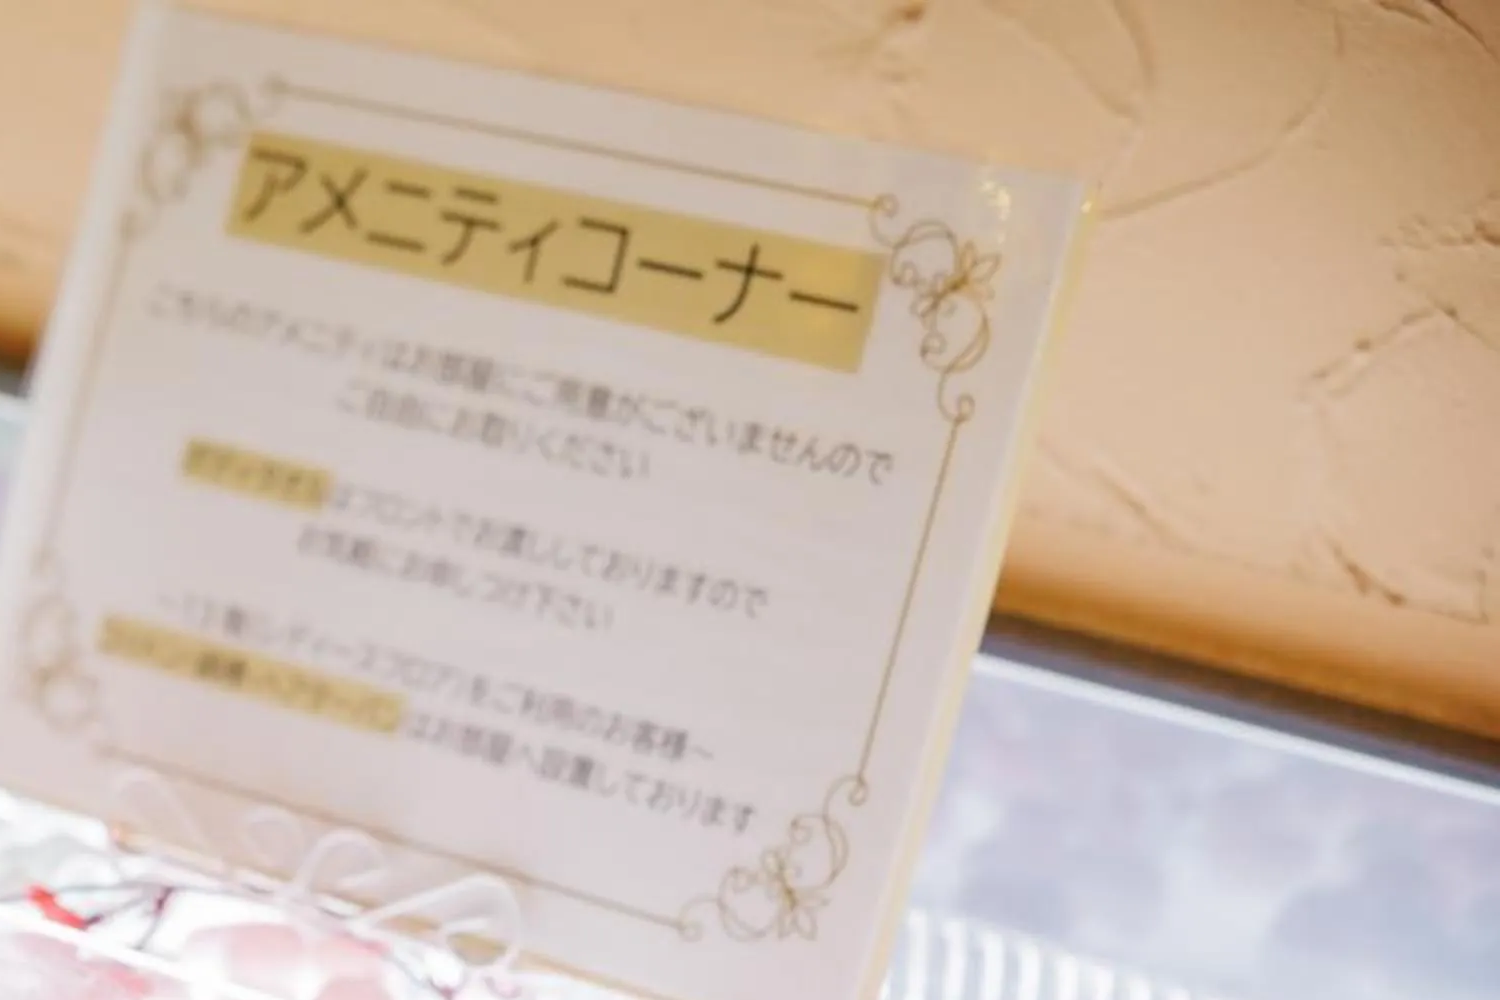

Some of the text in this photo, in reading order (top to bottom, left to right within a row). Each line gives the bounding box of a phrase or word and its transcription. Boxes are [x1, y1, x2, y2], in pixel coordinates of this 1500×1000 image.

[247, 146, 859, 325] アメニティコーナー
